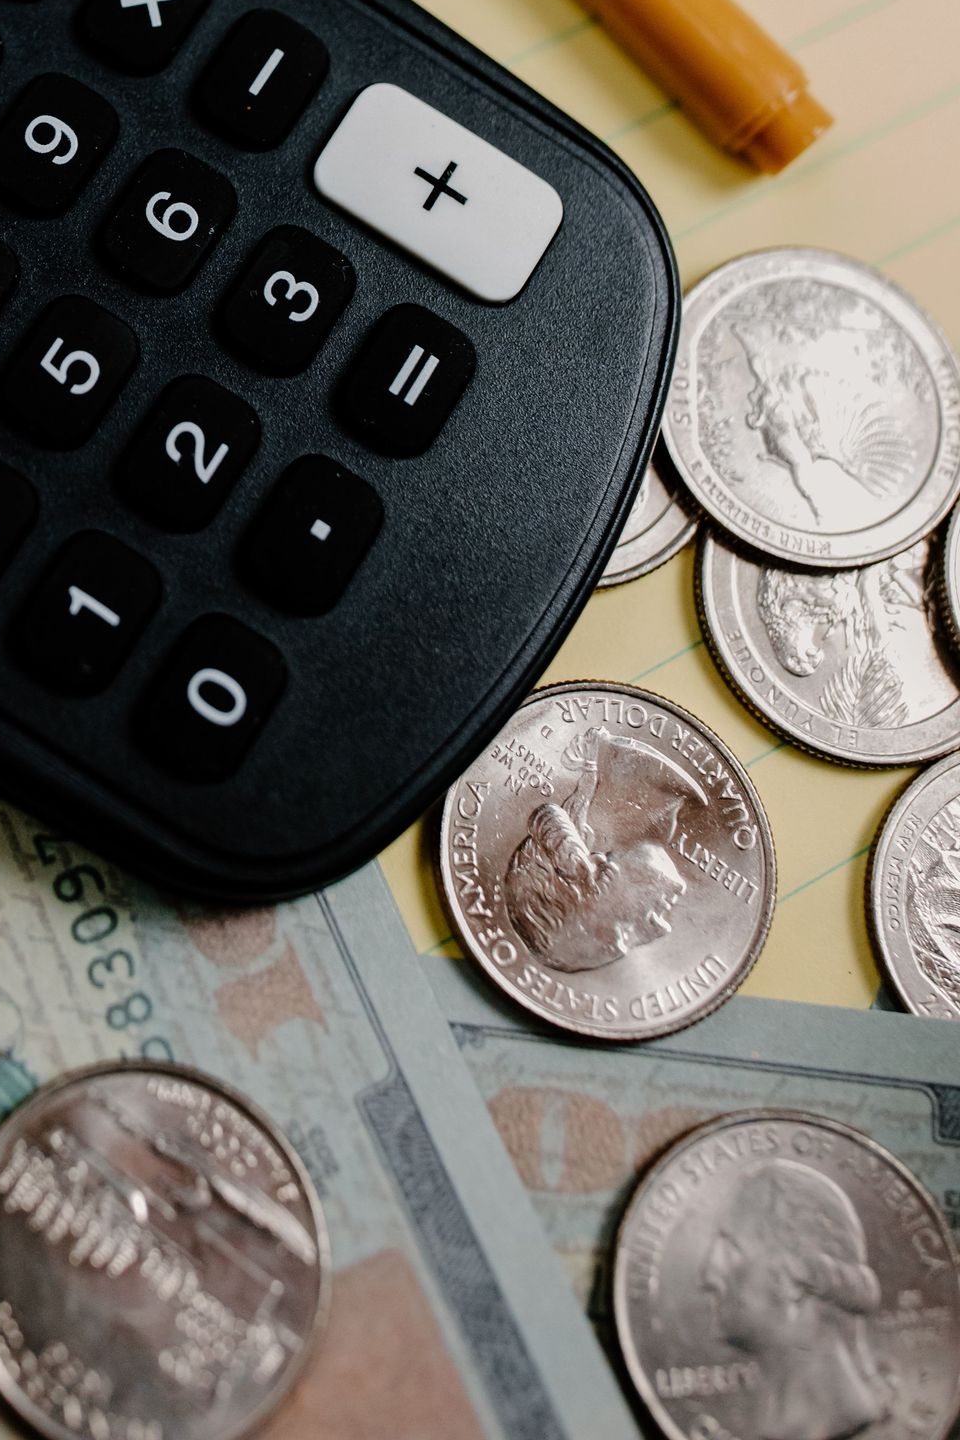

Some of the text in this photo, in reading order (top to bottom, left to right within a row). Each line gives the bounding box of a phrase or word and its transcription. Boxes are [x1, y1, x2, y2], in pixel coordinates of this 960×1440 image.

[24, 114, 79, 165] 9
[145, 191, 199, 242] 6
[263, 270, 320, 322] 3
[40, 337, 101, 395] 5
[165, 421, 230, 484] 2
[701, 472, 774, 544] PLURIBUS
[68, 585, 121, 627] 1
[187, 667, 248, 727] 0
[724, 629, 859, 748] EL YUNQUE
[504, 737, 555, 781] TRUST
[539, 723, 554, 741] D
[490, 745, 554, 799] GOD WE
[504, 774, 523, 797] IN
[554, 695, 757, 852] QUARTER DOLLAR
[671, 831, 759, 905] LIBERTY
[886, 812, 921, 932] NEW MEXICO
[450, 779, 728, 1023] UNITED STATES OF AMERICA
